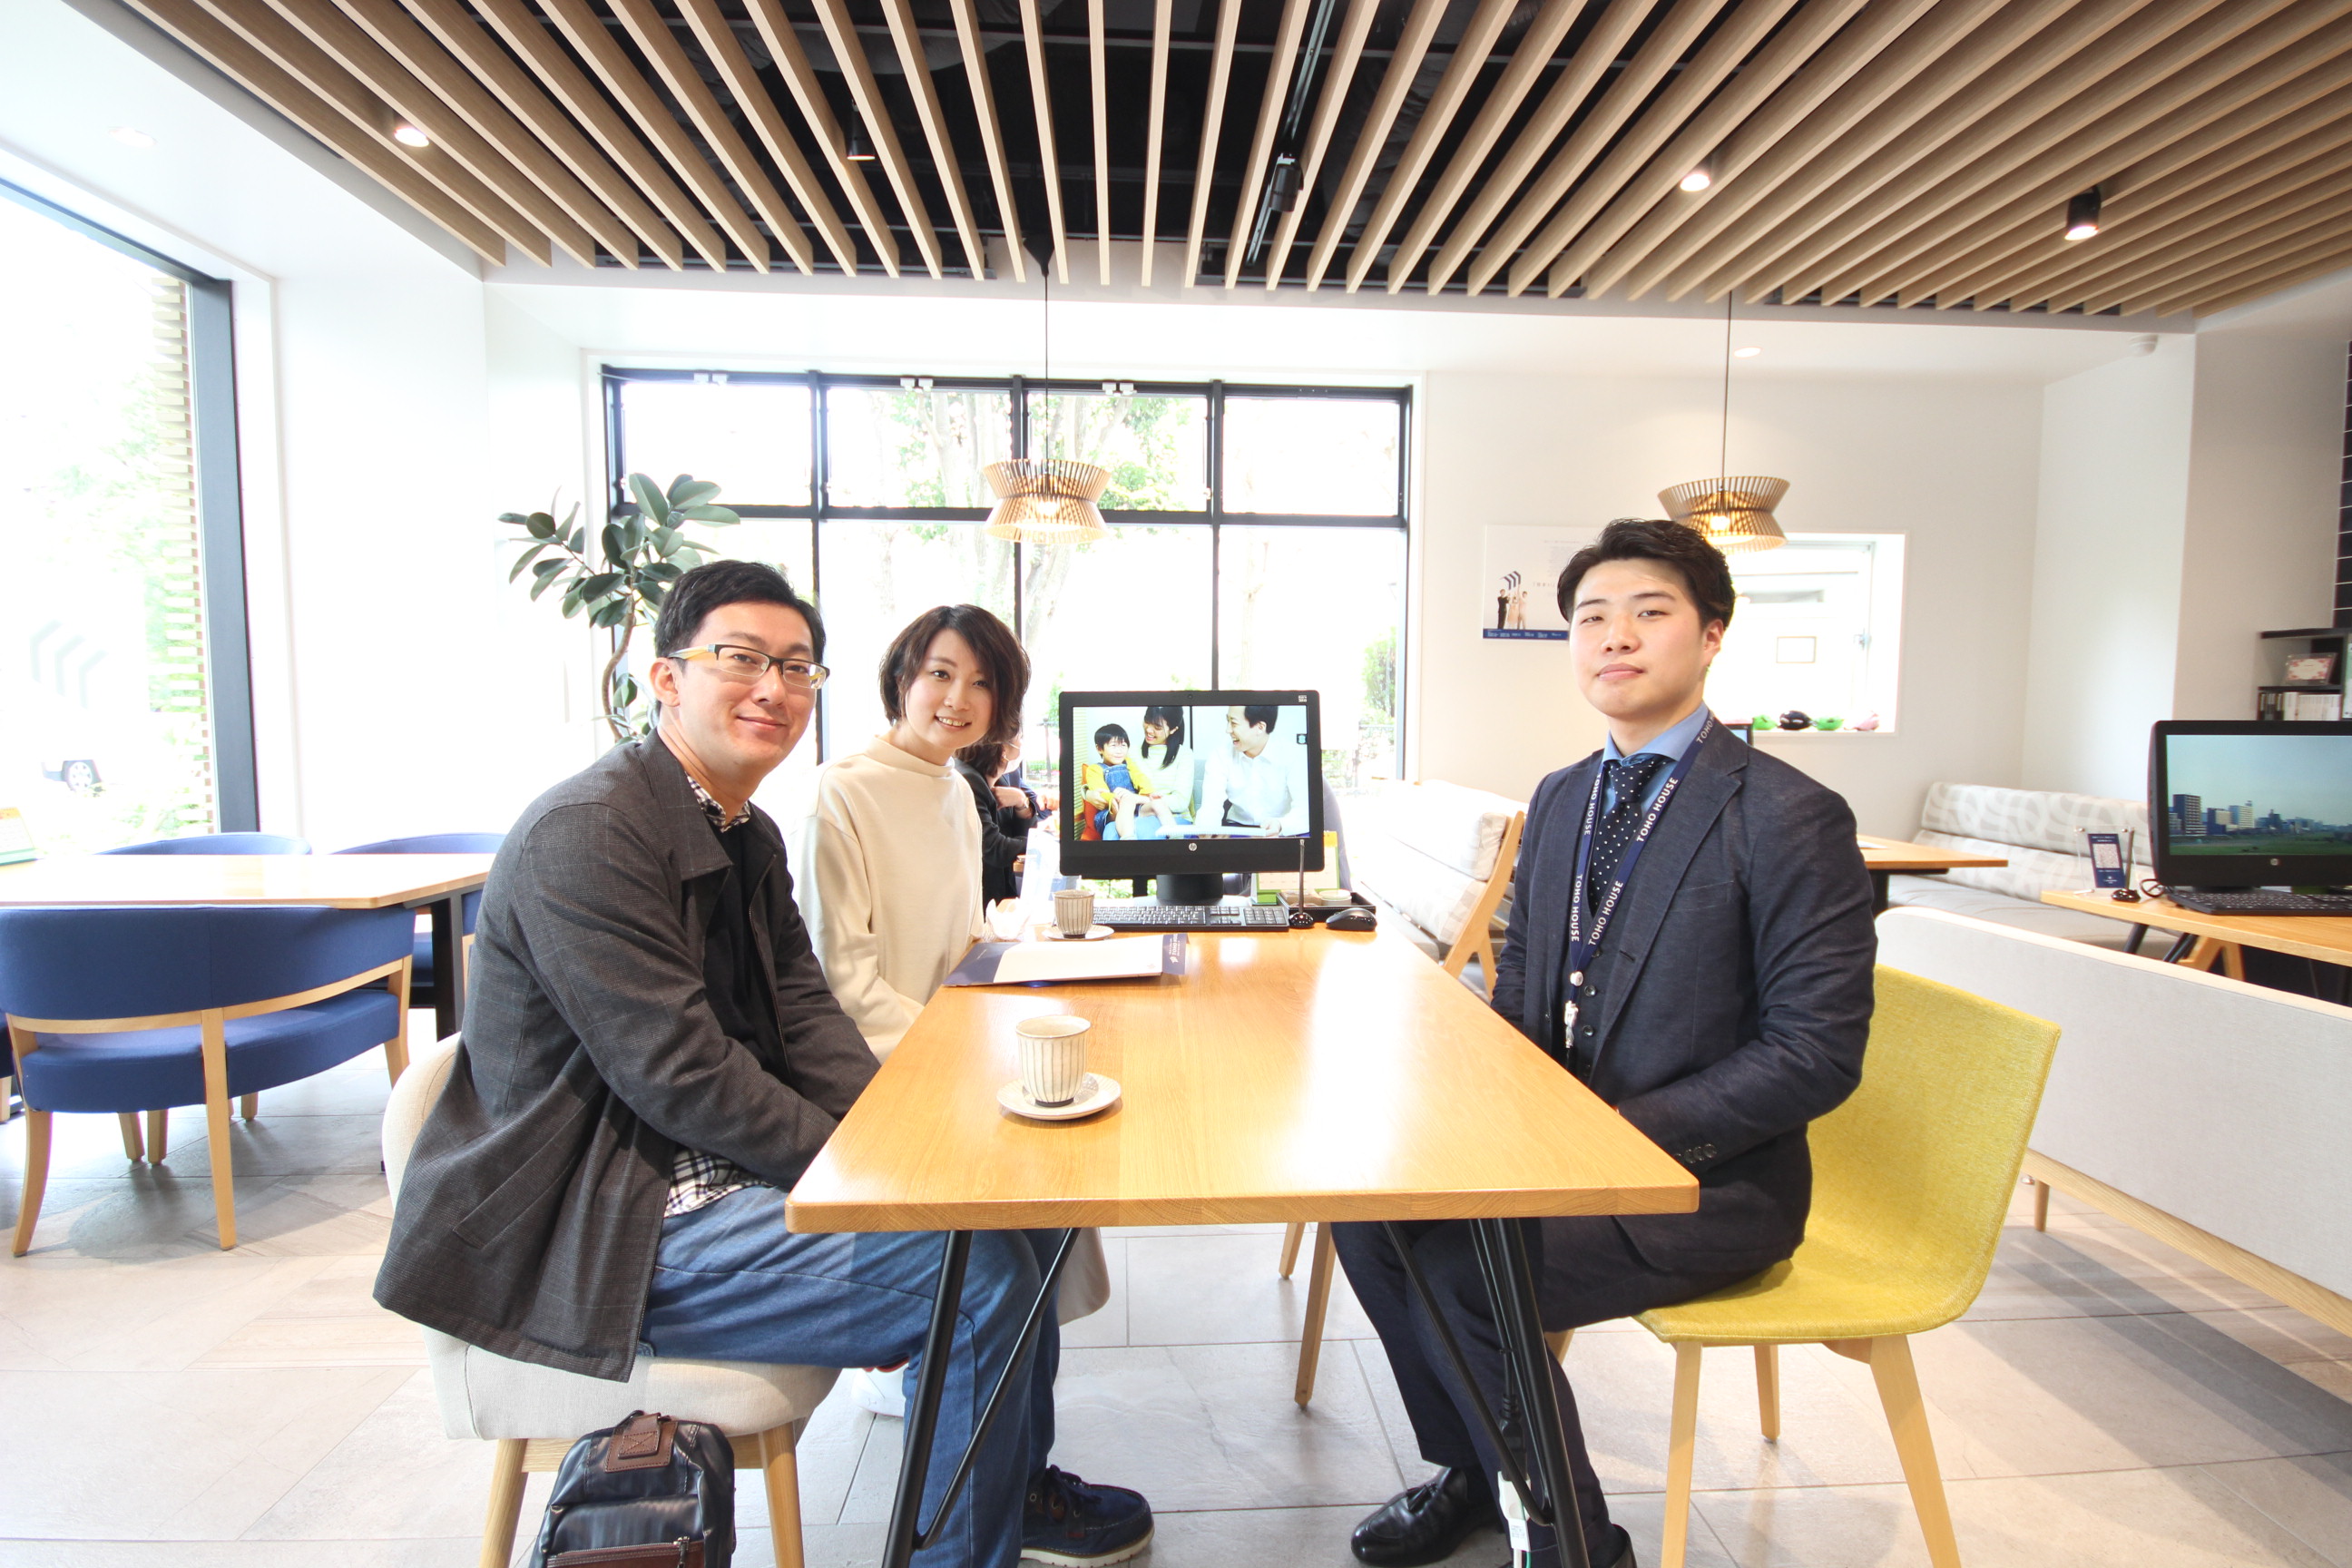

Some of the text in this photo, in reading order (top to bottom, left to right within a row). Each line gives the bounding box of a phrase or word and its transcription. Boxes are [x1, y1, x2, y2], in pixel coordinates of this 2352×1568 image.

[1696, 720, 1714, 744] TOHO
[1583, 772, 1602, 836] TOHO HOUSE
[1636, 777, 1679, 843] TOHO HOUSE
[1571, 874, 1583, 942] TOHO HOUSE
[1588, 880, 1624, 946] TOHO HOUSE
